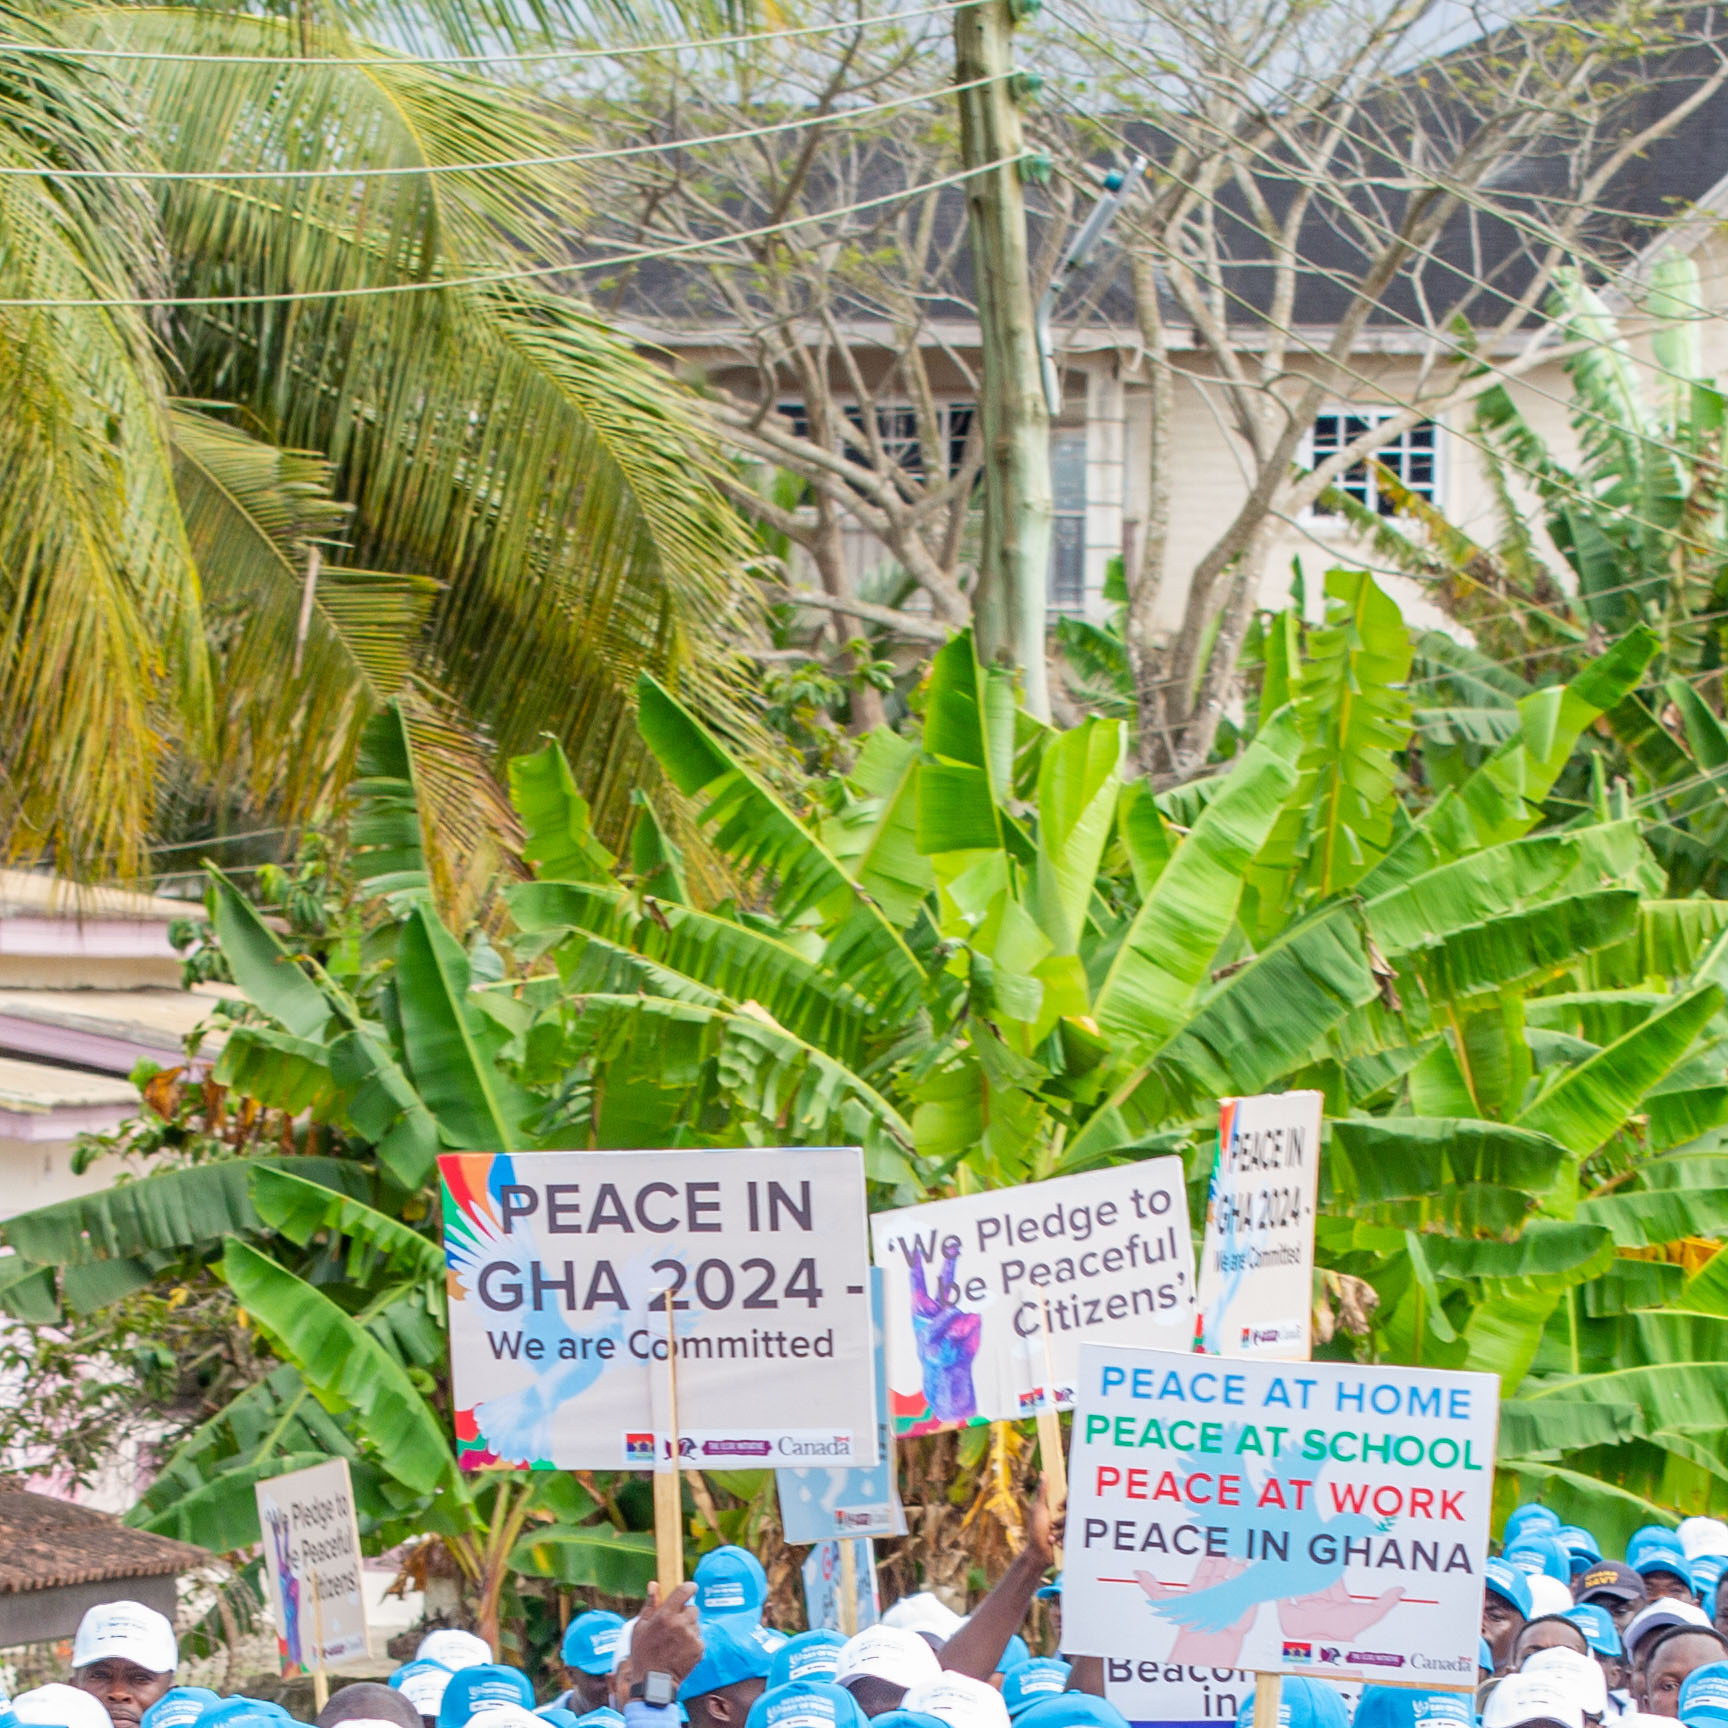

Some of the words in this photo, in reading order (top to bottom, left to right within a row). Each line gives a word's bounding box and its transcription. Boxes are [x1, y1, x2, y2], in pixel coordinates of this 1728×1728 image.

[1231, 1129, 1286, 1172] PEACE
[500, 1181, 722, 1235] PEACE
[747, 1179, 813, 1232] IN
[976, 1200, 1119, 1253] Pledge
[1130, 1188, 1172, 1219] to
[477, 1260, 630, 1311] GHA
[648, 1257, 823, 1310] 2024
[938, 1275, 987, 1307] be
[1000, 1226, 1178, 1295] Peaceful
[485, 1330, 545, 1360] We
[558, 1336, 616, 1360] are
[628, 1327, 834, 1360] Committed
[1100, 1366, 1246, 1406] PEACE
[1263, 1377, 1318, 1410] AT
[1336, 1382, 1472, 1420] HOME
[778, 1436, 851, 1456] Canada
[1085, 1414, 1223, 1454] PEACE
[1234, 1425, 1288, 1458] AT
[1302, 1428, 1483, 1471] SCHOOL
[1096, 1466, 1241, 1506] PEACE
[1257, 1478, 1313, 1511] AT
[1329, 1482, 1467, 1522] WORK
[1084, 1518, 1228, 1558] PEACE
[1246, 1528, 1289, 1562] IN
[1308, 1533, 1474, 1575] GHANA
[1410, 1652, 1472, 1672] Canada
[1204, 1685, 1238, 1717] in
